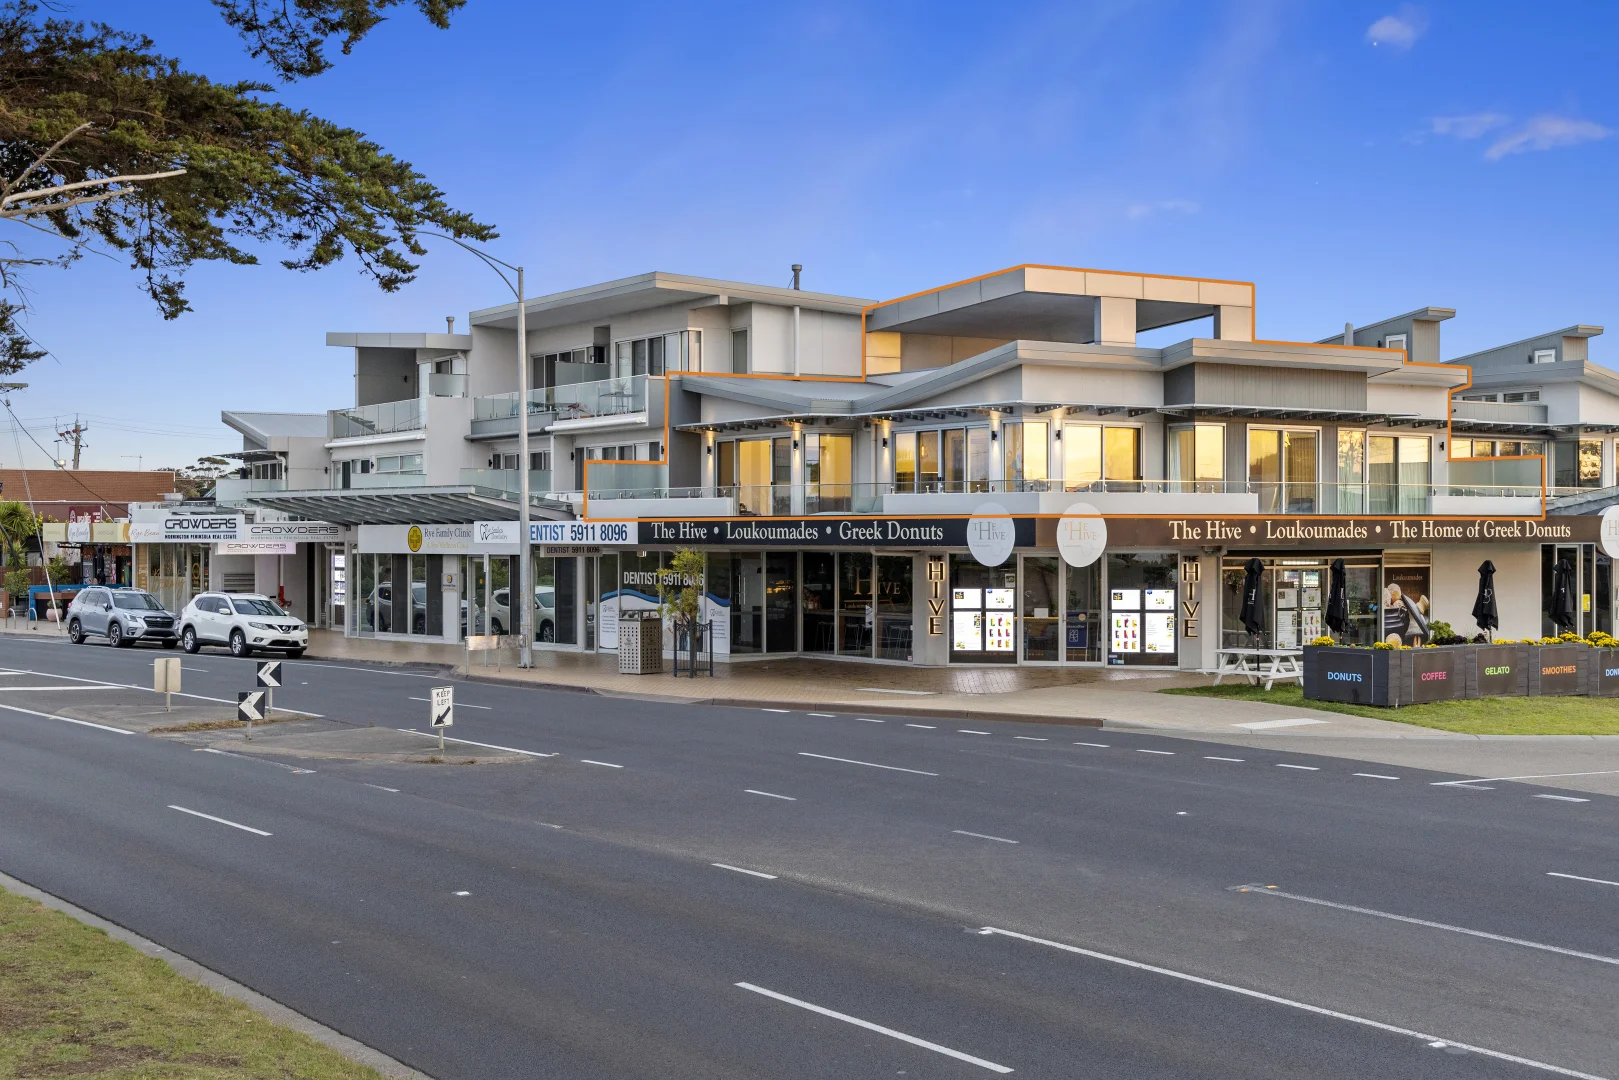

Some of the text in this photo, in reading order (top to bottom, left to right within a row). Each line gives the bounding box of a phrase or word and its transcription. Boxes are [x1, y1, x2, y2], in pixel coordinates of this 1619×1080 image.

[164, 518, 237, 529] CROWDERS
[650, 521, 708, 539] The Hive
[726, 520, 818, 540] Loukoumades
[839, 520, 944, 540] Greek Donuts
[1168, 520, 1241, 539] The Hive
[1265, 520, 1367, 539] Loukoumades
[1389, 519, 1571, 538] The Home of Greek Donuts
[424, 527, 471, 540] Rye Family Clinic
[530, 524, 628, 541] ENTIST 5911 8096
[546, 546, 600, 554] DENTIST 5911 8096
[623, 571, 657, 584] DENTIST
[663, 573, 681, 586] 5911
[928, 563, 944, 634] HIVE
[1182, 564, 1200, 637] HIVE
[1327, 671, 1363, 682] DONUTS
[1421, 671, 1447, 681] COFFEE
[1485, 666, 1511, 675] GELATO
[1542, 665, 1577, 675] SMOOTHIES
[437, 698, 450, 706] LEFT
